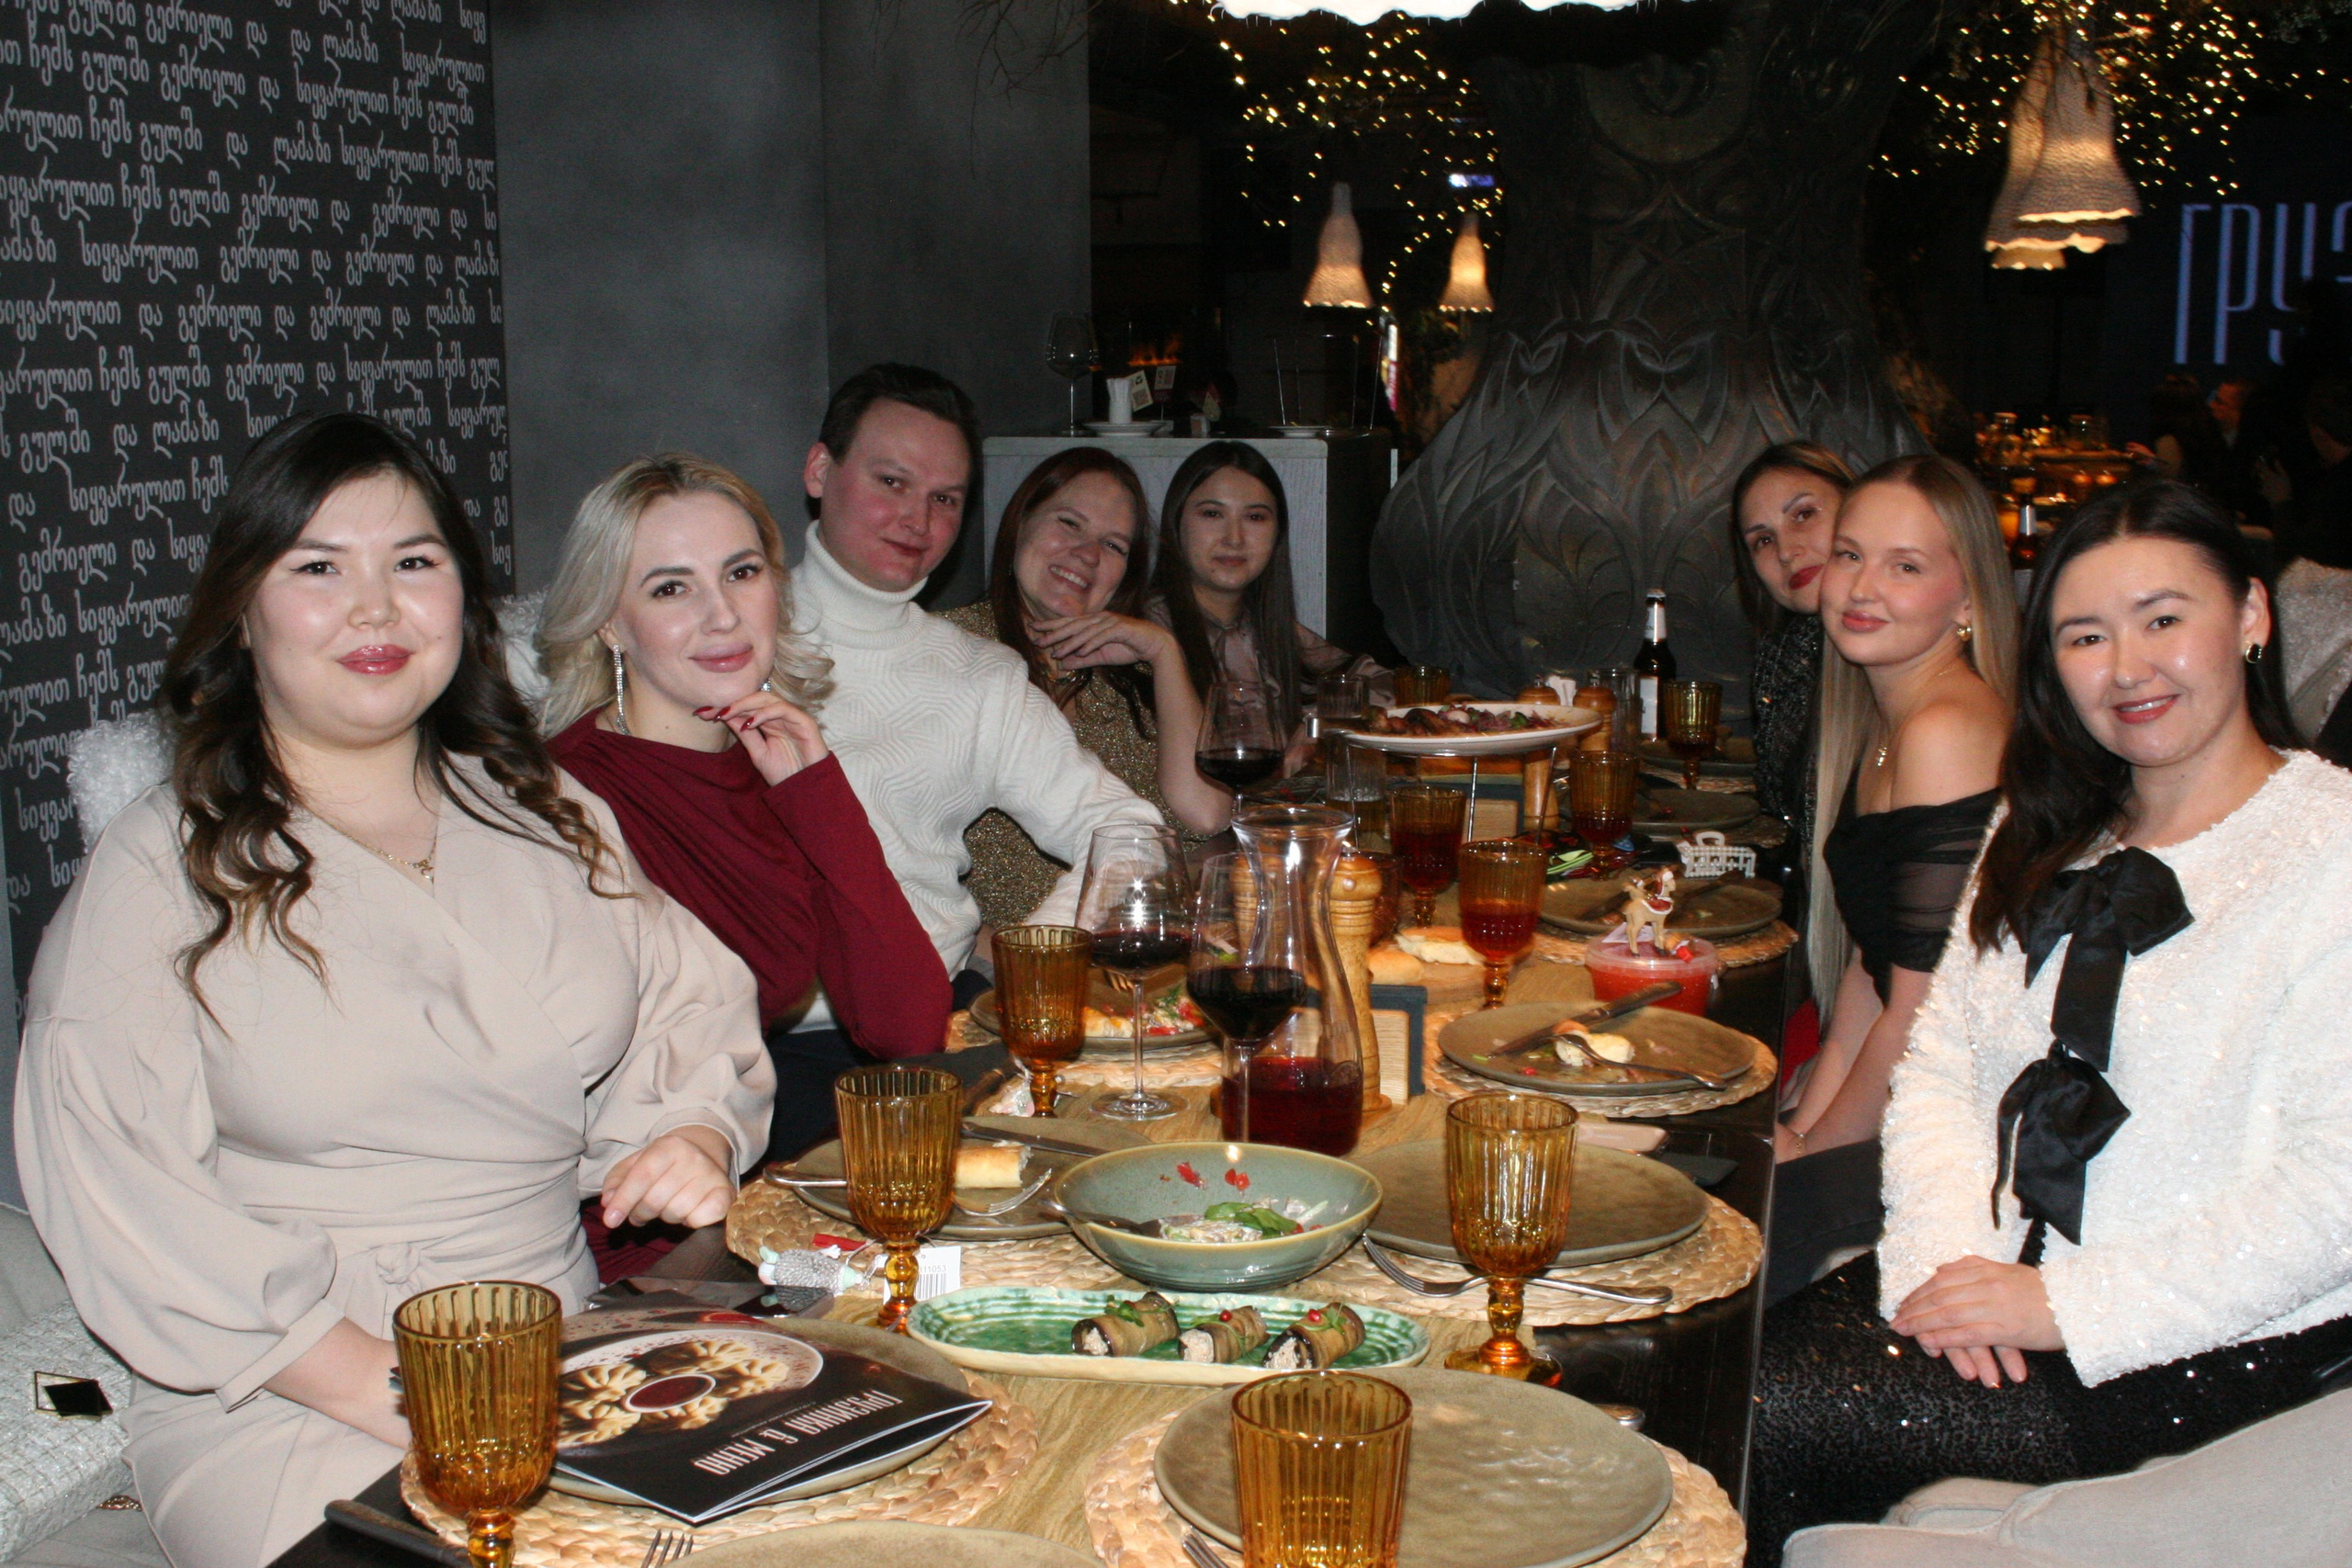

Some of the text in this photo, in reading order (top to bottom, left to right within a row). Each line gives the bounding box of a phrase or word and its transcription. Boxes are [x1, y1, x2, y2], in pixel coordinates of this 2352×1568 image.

[245, 20, 267, 59] და
[290, 28, 311, 65] და
[259, 76, 280, 114] და
[227, 131, 248, 169] და
[331, 199, 351, 234] და
[450, 209, 468, 242] და
[311, 249, 331, 285] და
[425, 254, 444, 288] და
[139, 304, 163, 342] და
[275, 305, 295, 342] და
[392, 306, 411, 339] და
[316, 362, 336, 397] და
[113, 423, 138, 462] და
[8, 491, 36, 534] და
[131, 537, 155, 576] და
[785, 1389, 903, 1435] ГРУЗИНКА
[694, 1438, 775, 1475] МЕНЮ
